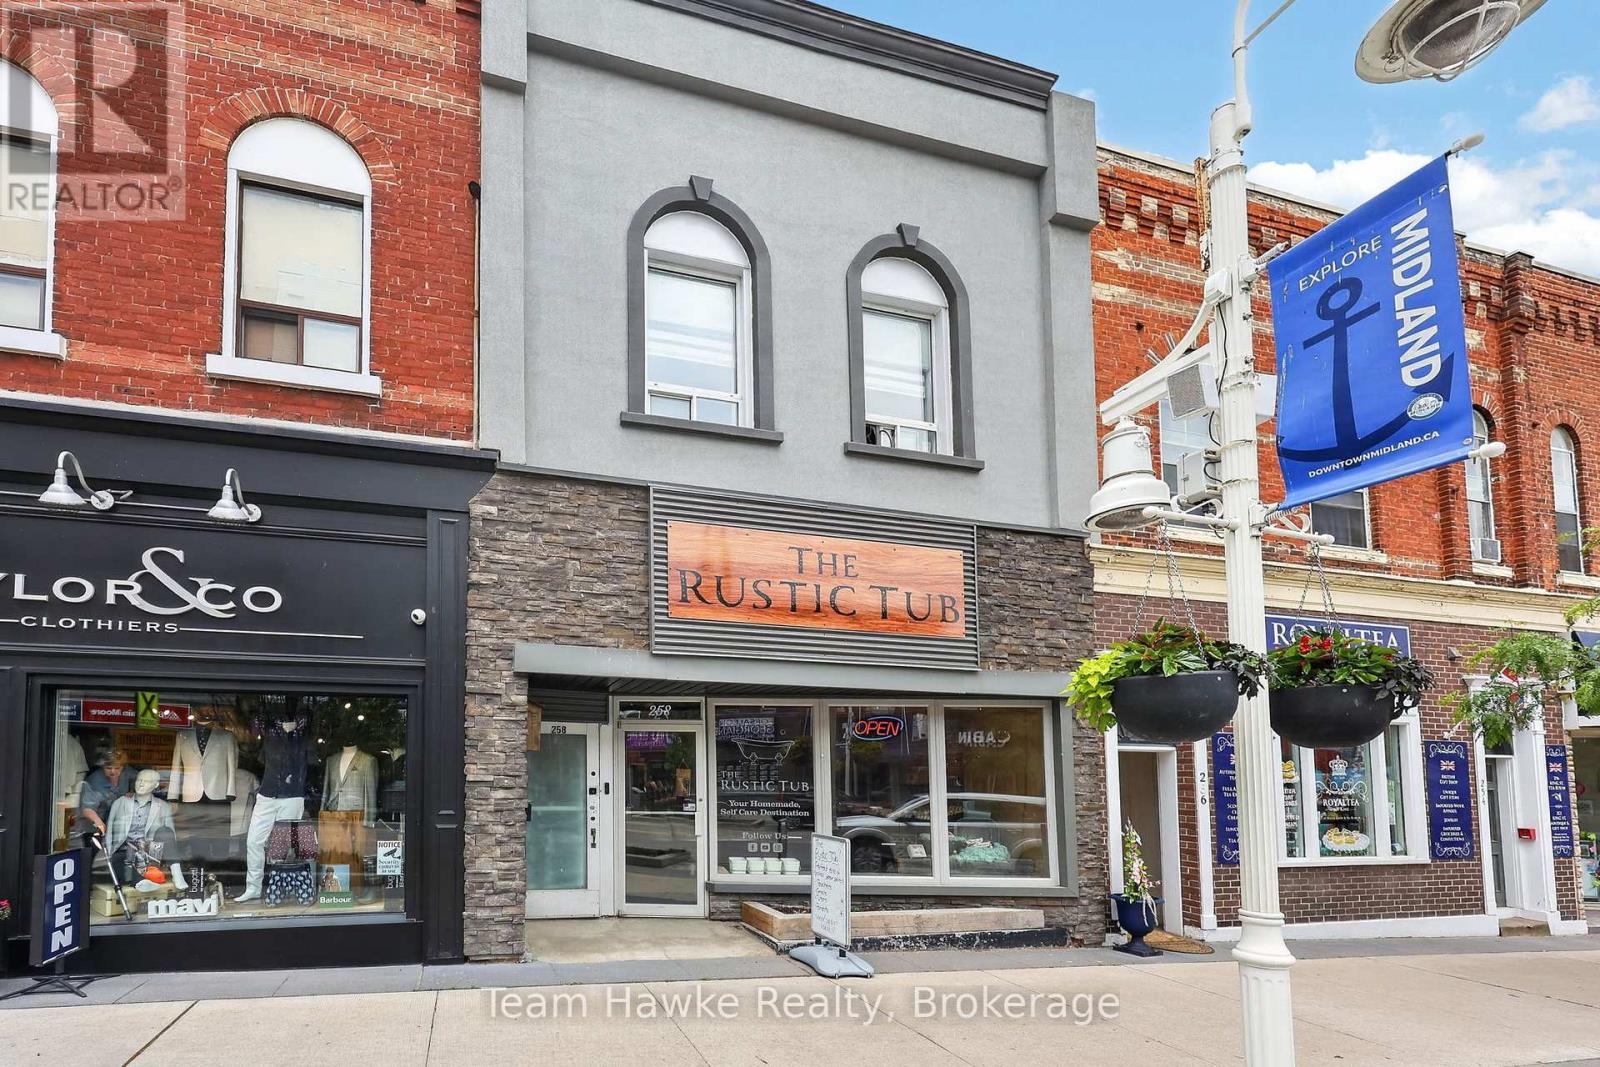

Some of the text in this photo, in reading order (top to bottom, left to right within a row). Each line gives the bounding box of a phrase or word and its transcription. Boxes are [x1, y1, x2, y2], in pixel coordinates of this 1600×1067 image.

[1299, 235, 1382, 292] EXPLORE
[1390, 207, 1442, 388] MIDLAND
[1308, 430, 1440, 479] DOWNTOWNMIDLAND.CA
[788, 546, 859, 579] THE
[676, 568, 960, 623] RUSTIC TUB
[20, 615, 178, 633] CLOTHIERS
[551, 725, 567, 734] 258
[855, 720, 900, 736] OPEN
[721, 780, 809, 792] RUSTIC TUB
[750, 800, 801, 808] Homemade,
[1322, 798, 1360, 807] ROYALTEA
[720, 808, 738, 816] Self
[760, 809, 809, 817] Destination
[742, 831, 773, 839] Follow
[50, 858, 75, 953] OPEN
[147, 893, 219, 918] mavi
[320, 896, 352, 904] Barbour
